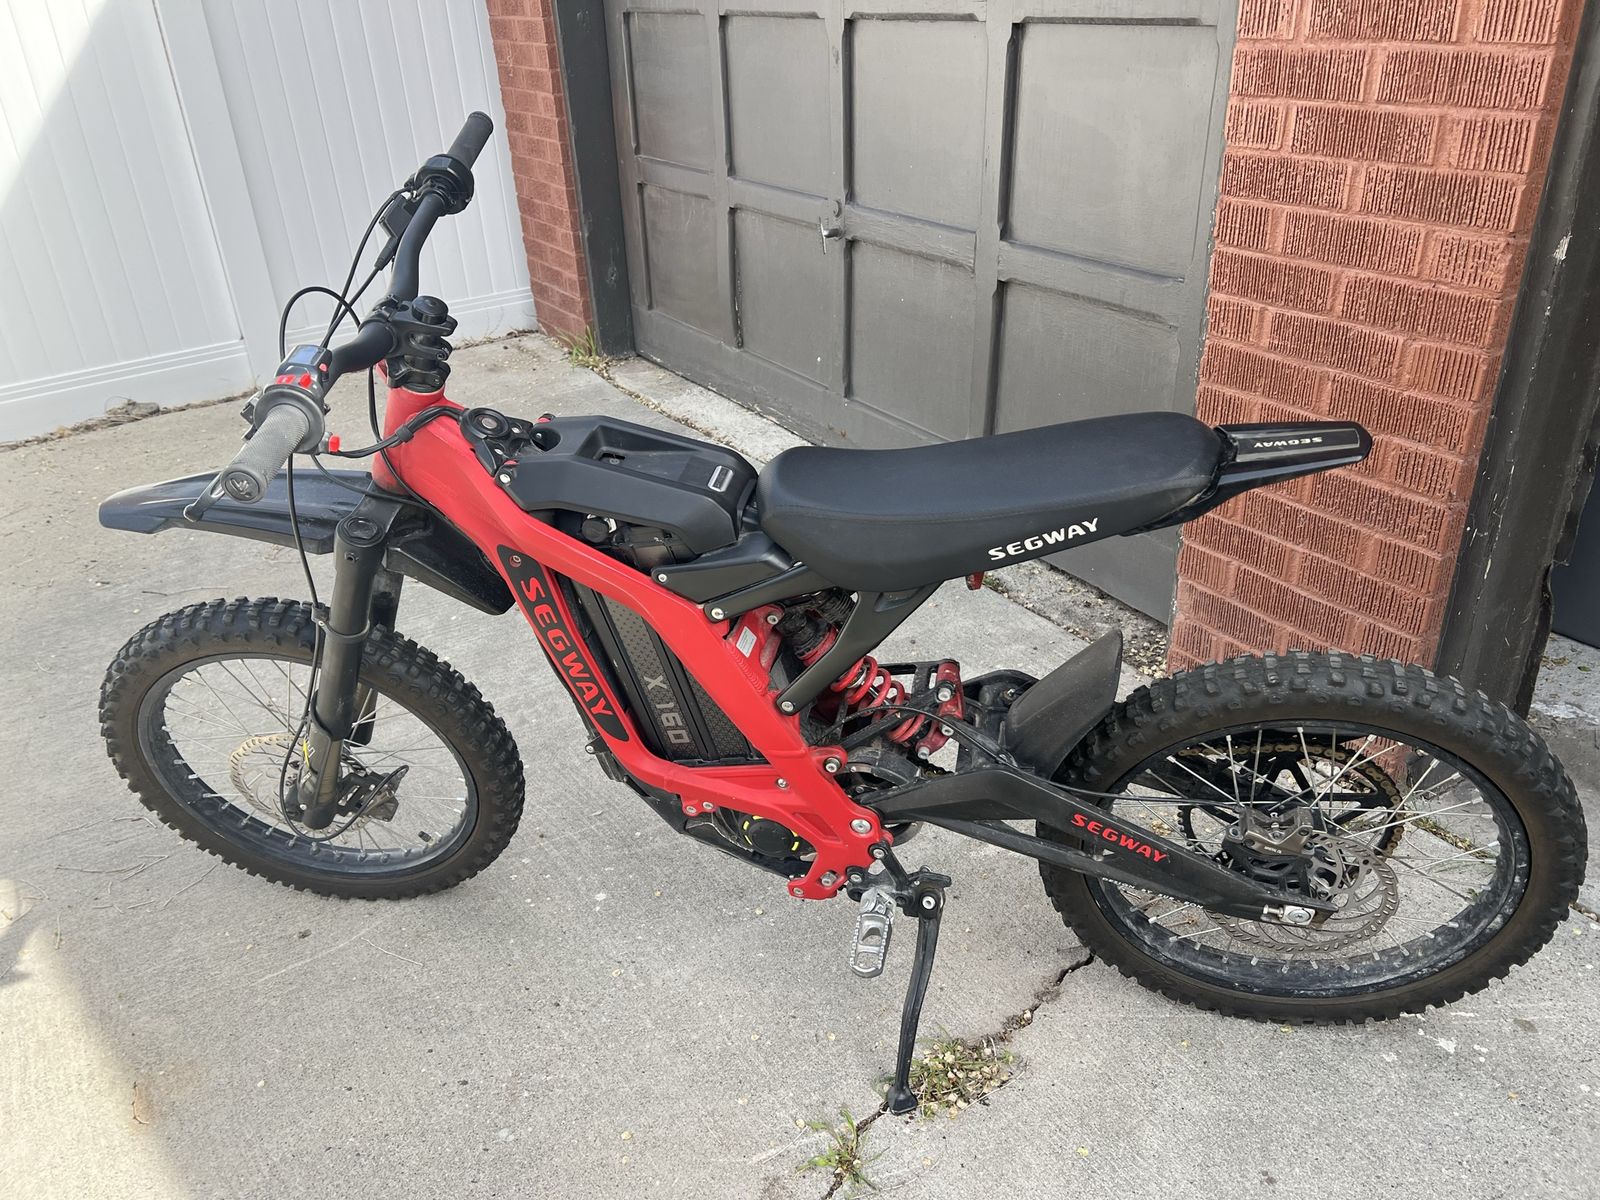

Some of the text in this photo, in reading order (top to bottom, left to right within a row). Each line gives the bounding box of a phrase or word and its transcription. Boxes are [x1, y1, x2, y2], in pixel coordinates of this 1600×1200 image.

[1254, 436, 1323, 448] SEGWAY
[987, 517, 1098, 561] SEGWAY
[521, 576, 614, 717] SEGWAY
[1070, 813, 1167, 863] SEGWAY
